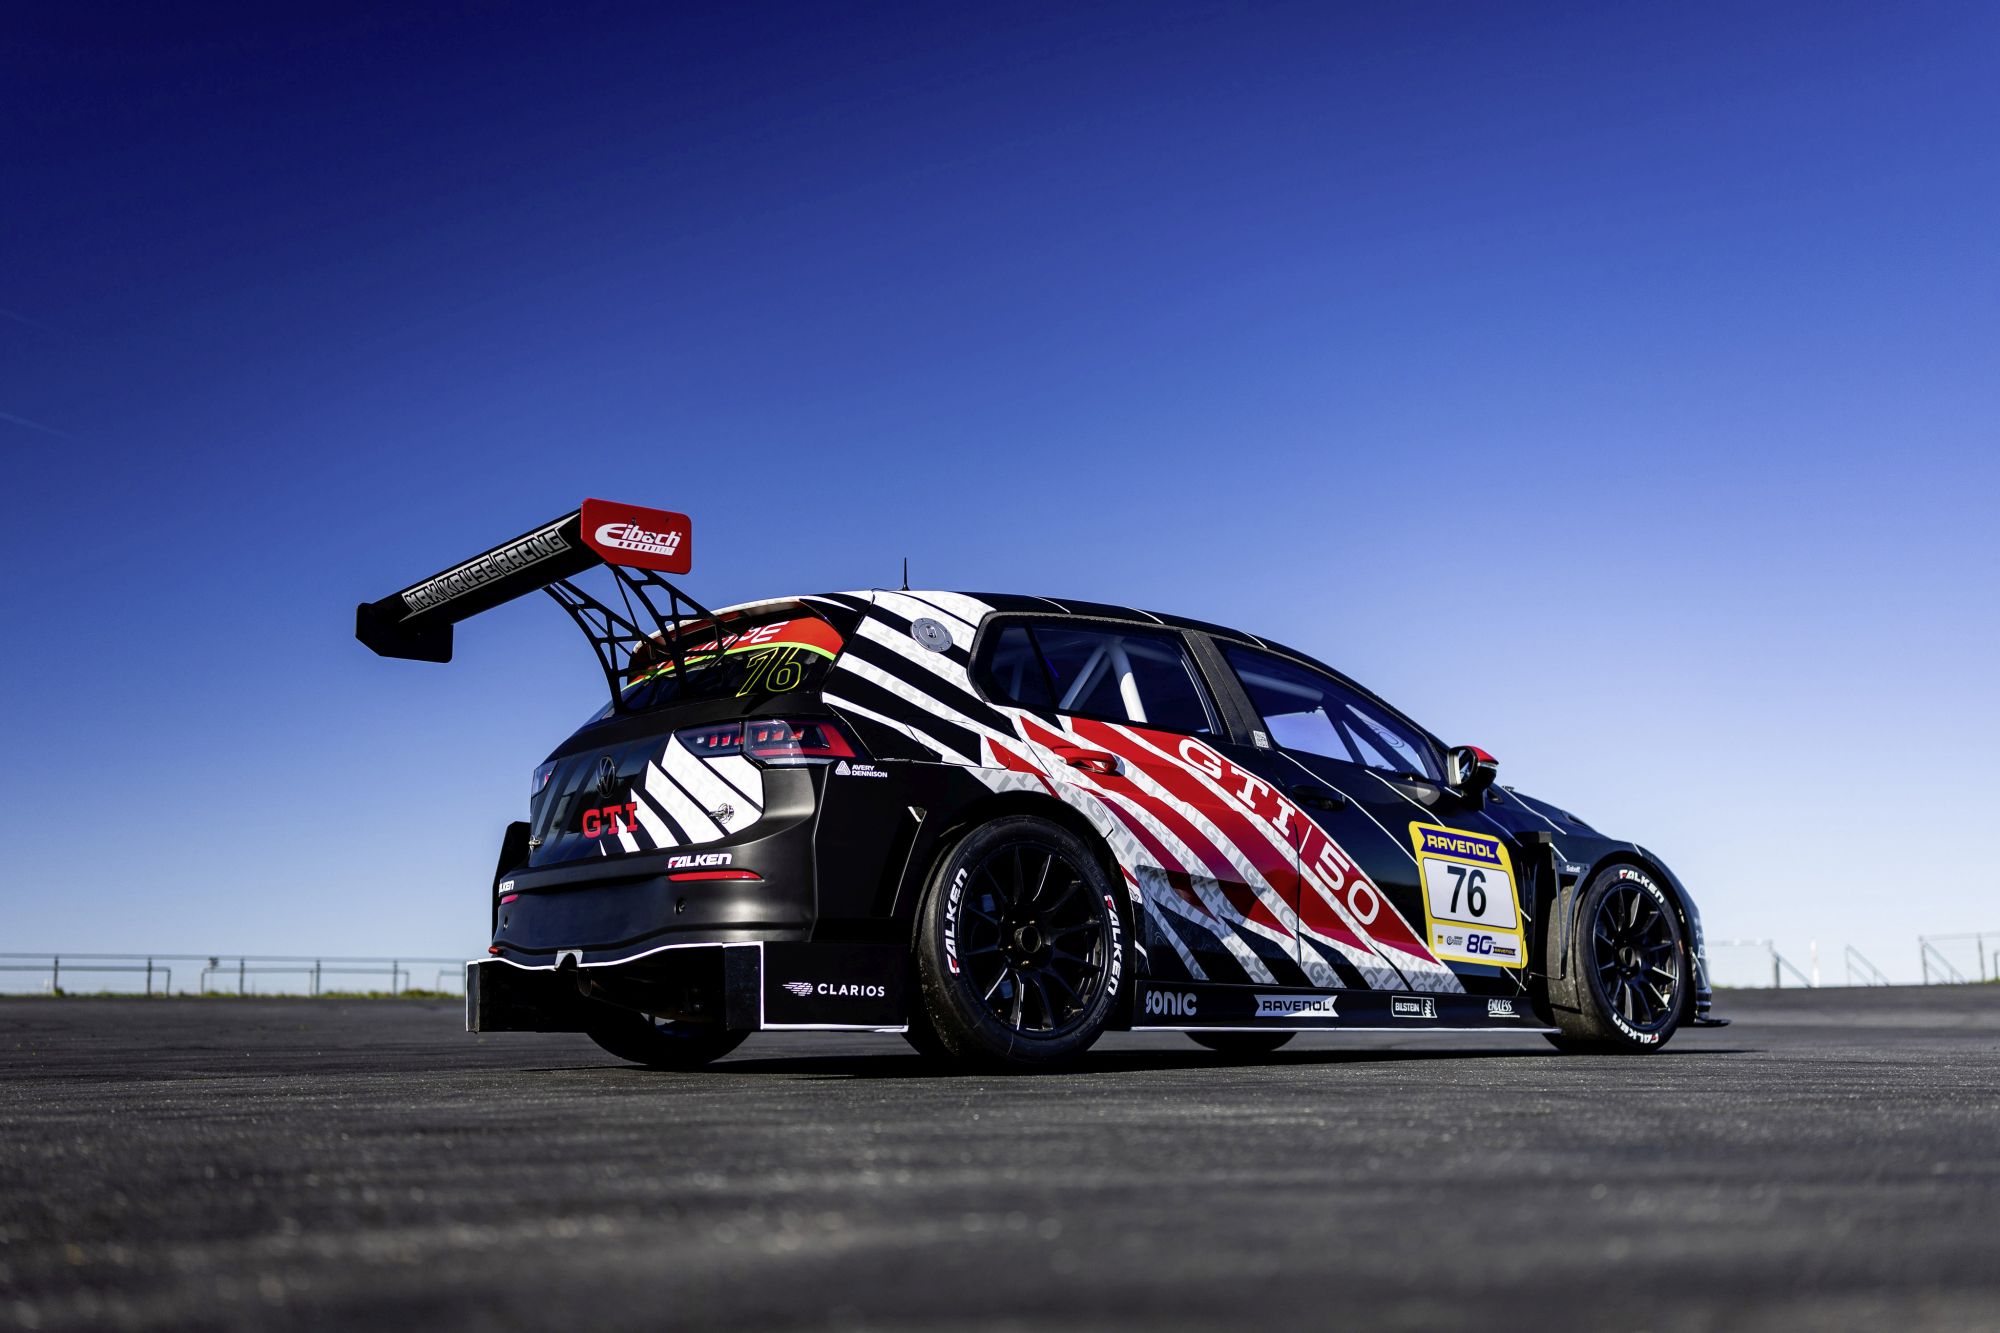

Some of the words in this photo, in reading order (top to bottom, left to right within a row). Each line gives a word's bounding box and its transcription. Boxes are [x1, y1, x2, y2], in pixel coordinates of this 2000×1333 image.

[595, 523, 681, 548] Eibach
[405, 583, 444, 611] MAX
[438, 558, 500, 597] KRUSE
[494, 530, 566, 572] RACING
[735, 646, 802, 698] 76
[852, 770, 888, 778] DENNISON
[582, 802, 638, 839] GTI
[1427, 834, 1496, 859] RAVENOL
[667, 853, 732, 869] FALKEN
[499, 880, 515, 893] LKEN
[1447, 865, 1487, 918] 76
[1619, 869, 1665, 904] FALKEN
[944, 868, 968, 977] FALKEN
[1104, 894, 1122, 996] FALKEN
[817, 983, 886, 997] CLARIOS
[1263, 1001, 1330, 1012] RAVENOL
[1395, 1002, 1420, 1012] BILSTEIN
[1612, 1013, 1659, 1044] FALKEN
